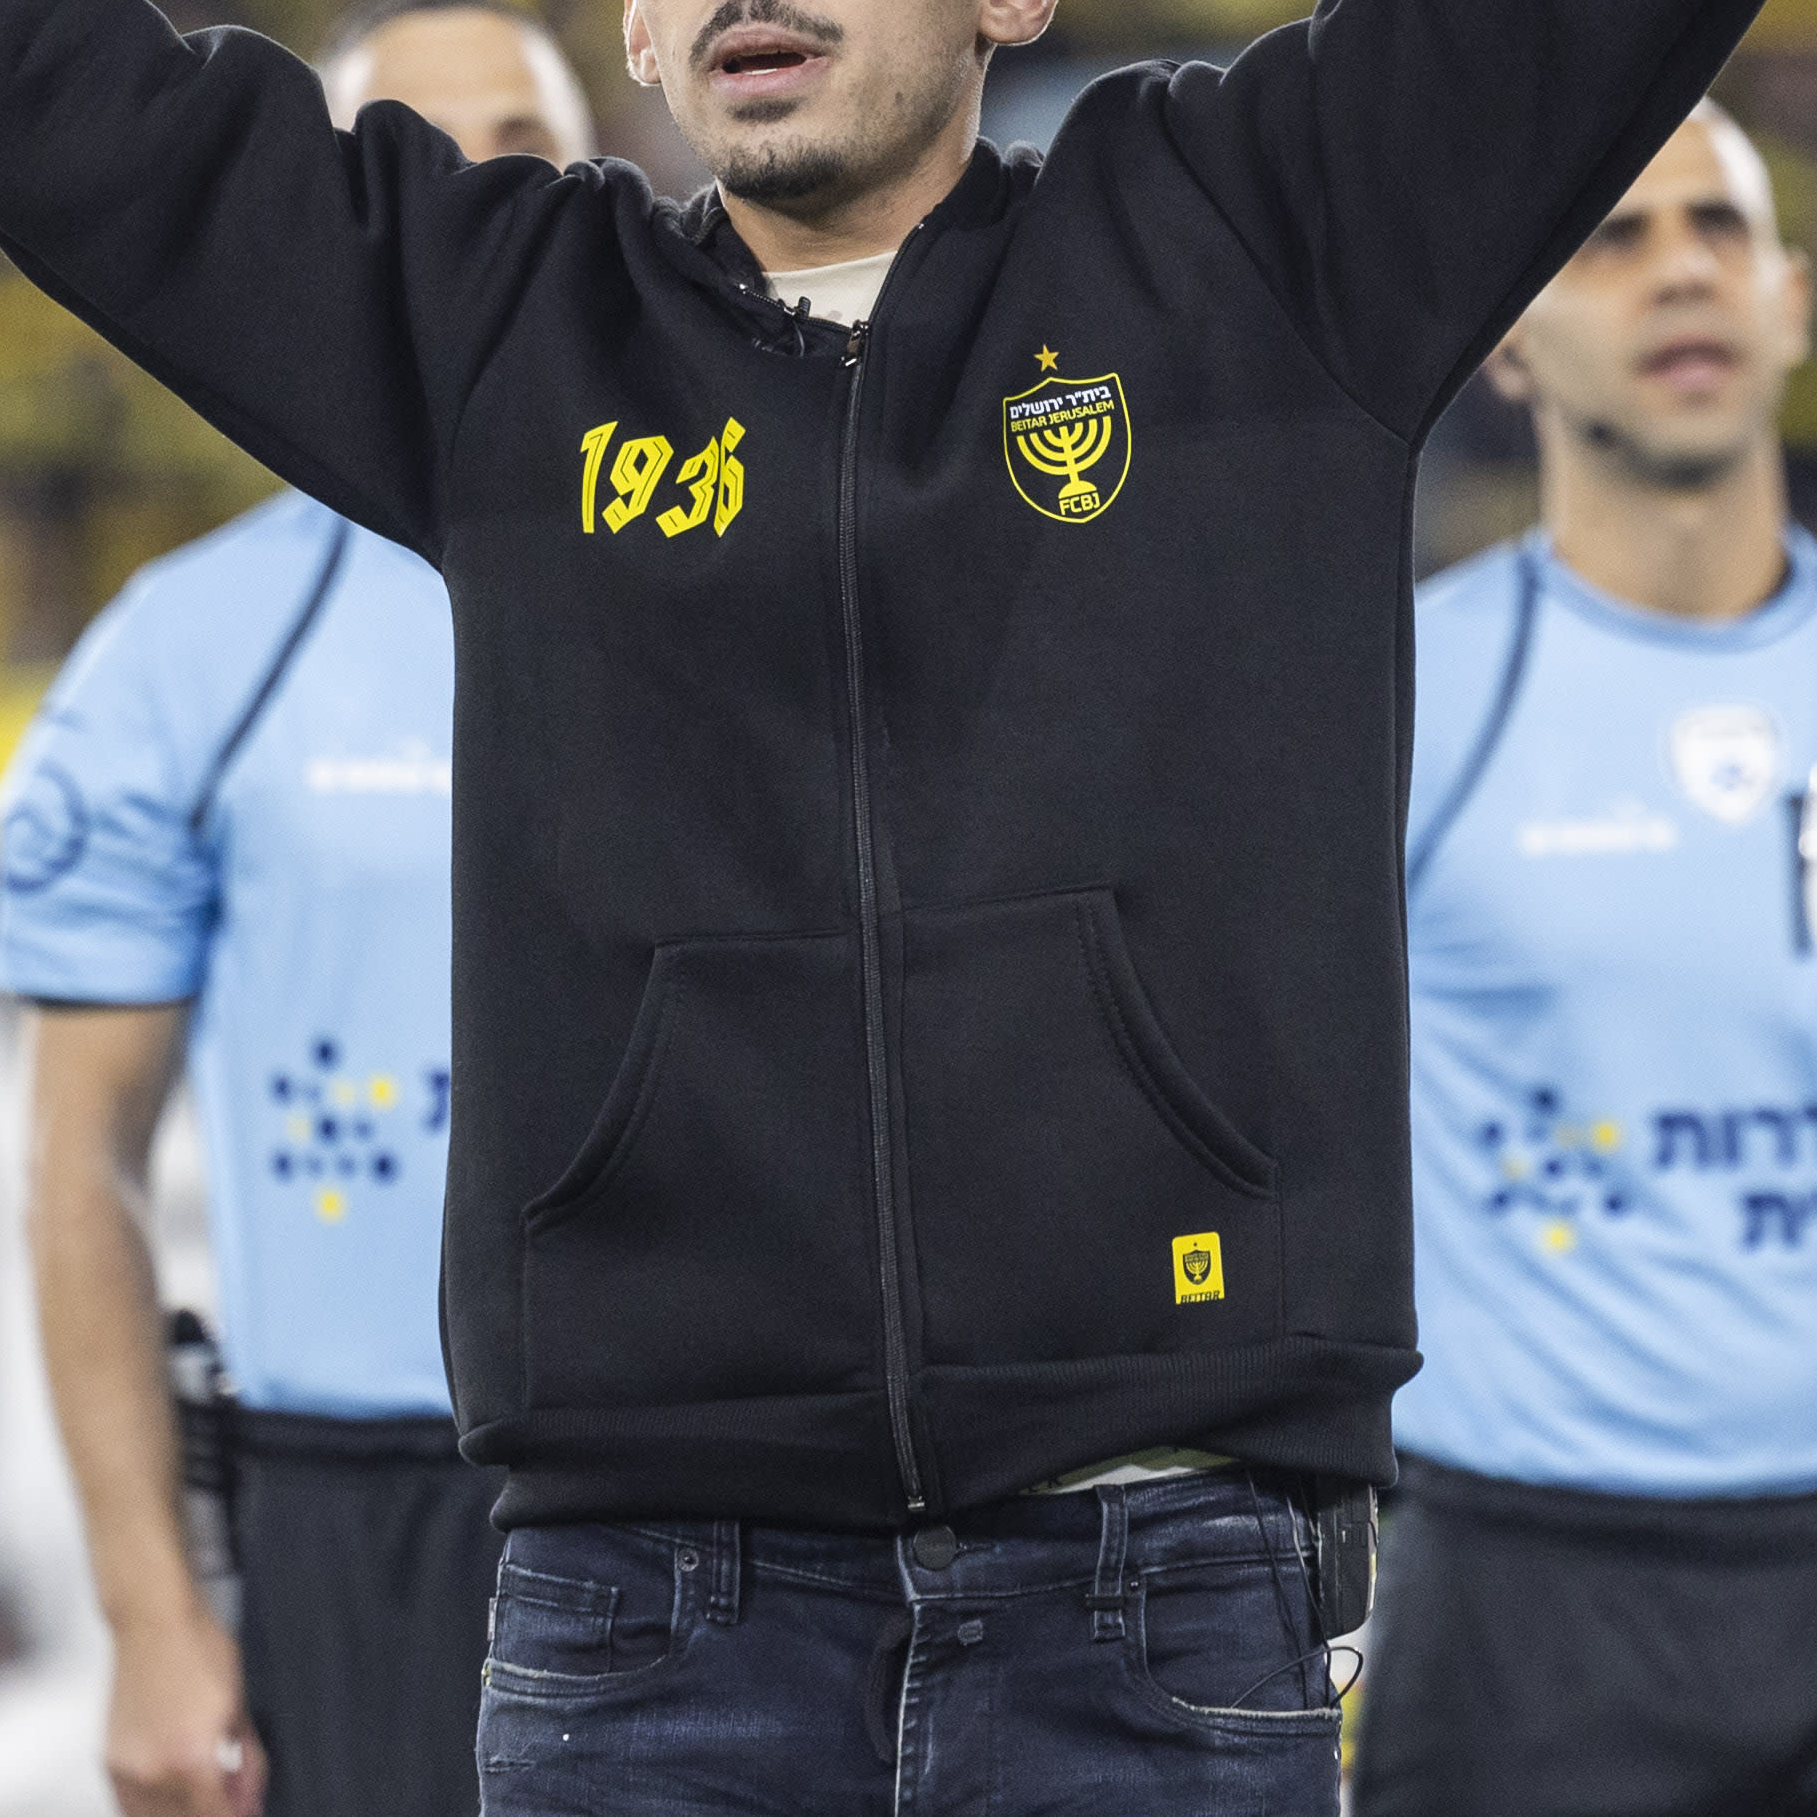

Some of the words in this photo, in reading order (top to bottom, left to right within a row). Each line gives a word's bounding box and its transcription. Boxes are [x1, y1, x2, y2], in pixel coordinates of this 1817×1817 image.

[1009, 396, 1064, 420] ירושלים
[1065, 385, 1112, 407] בית"ר
[1010, 415, 1049, 433] BEITAR
[1048, 399, 1115, 426] JERUSALEM
[581, 416, 746, 538] 1936
[1058, 492, 1101, 516] FCBJ
